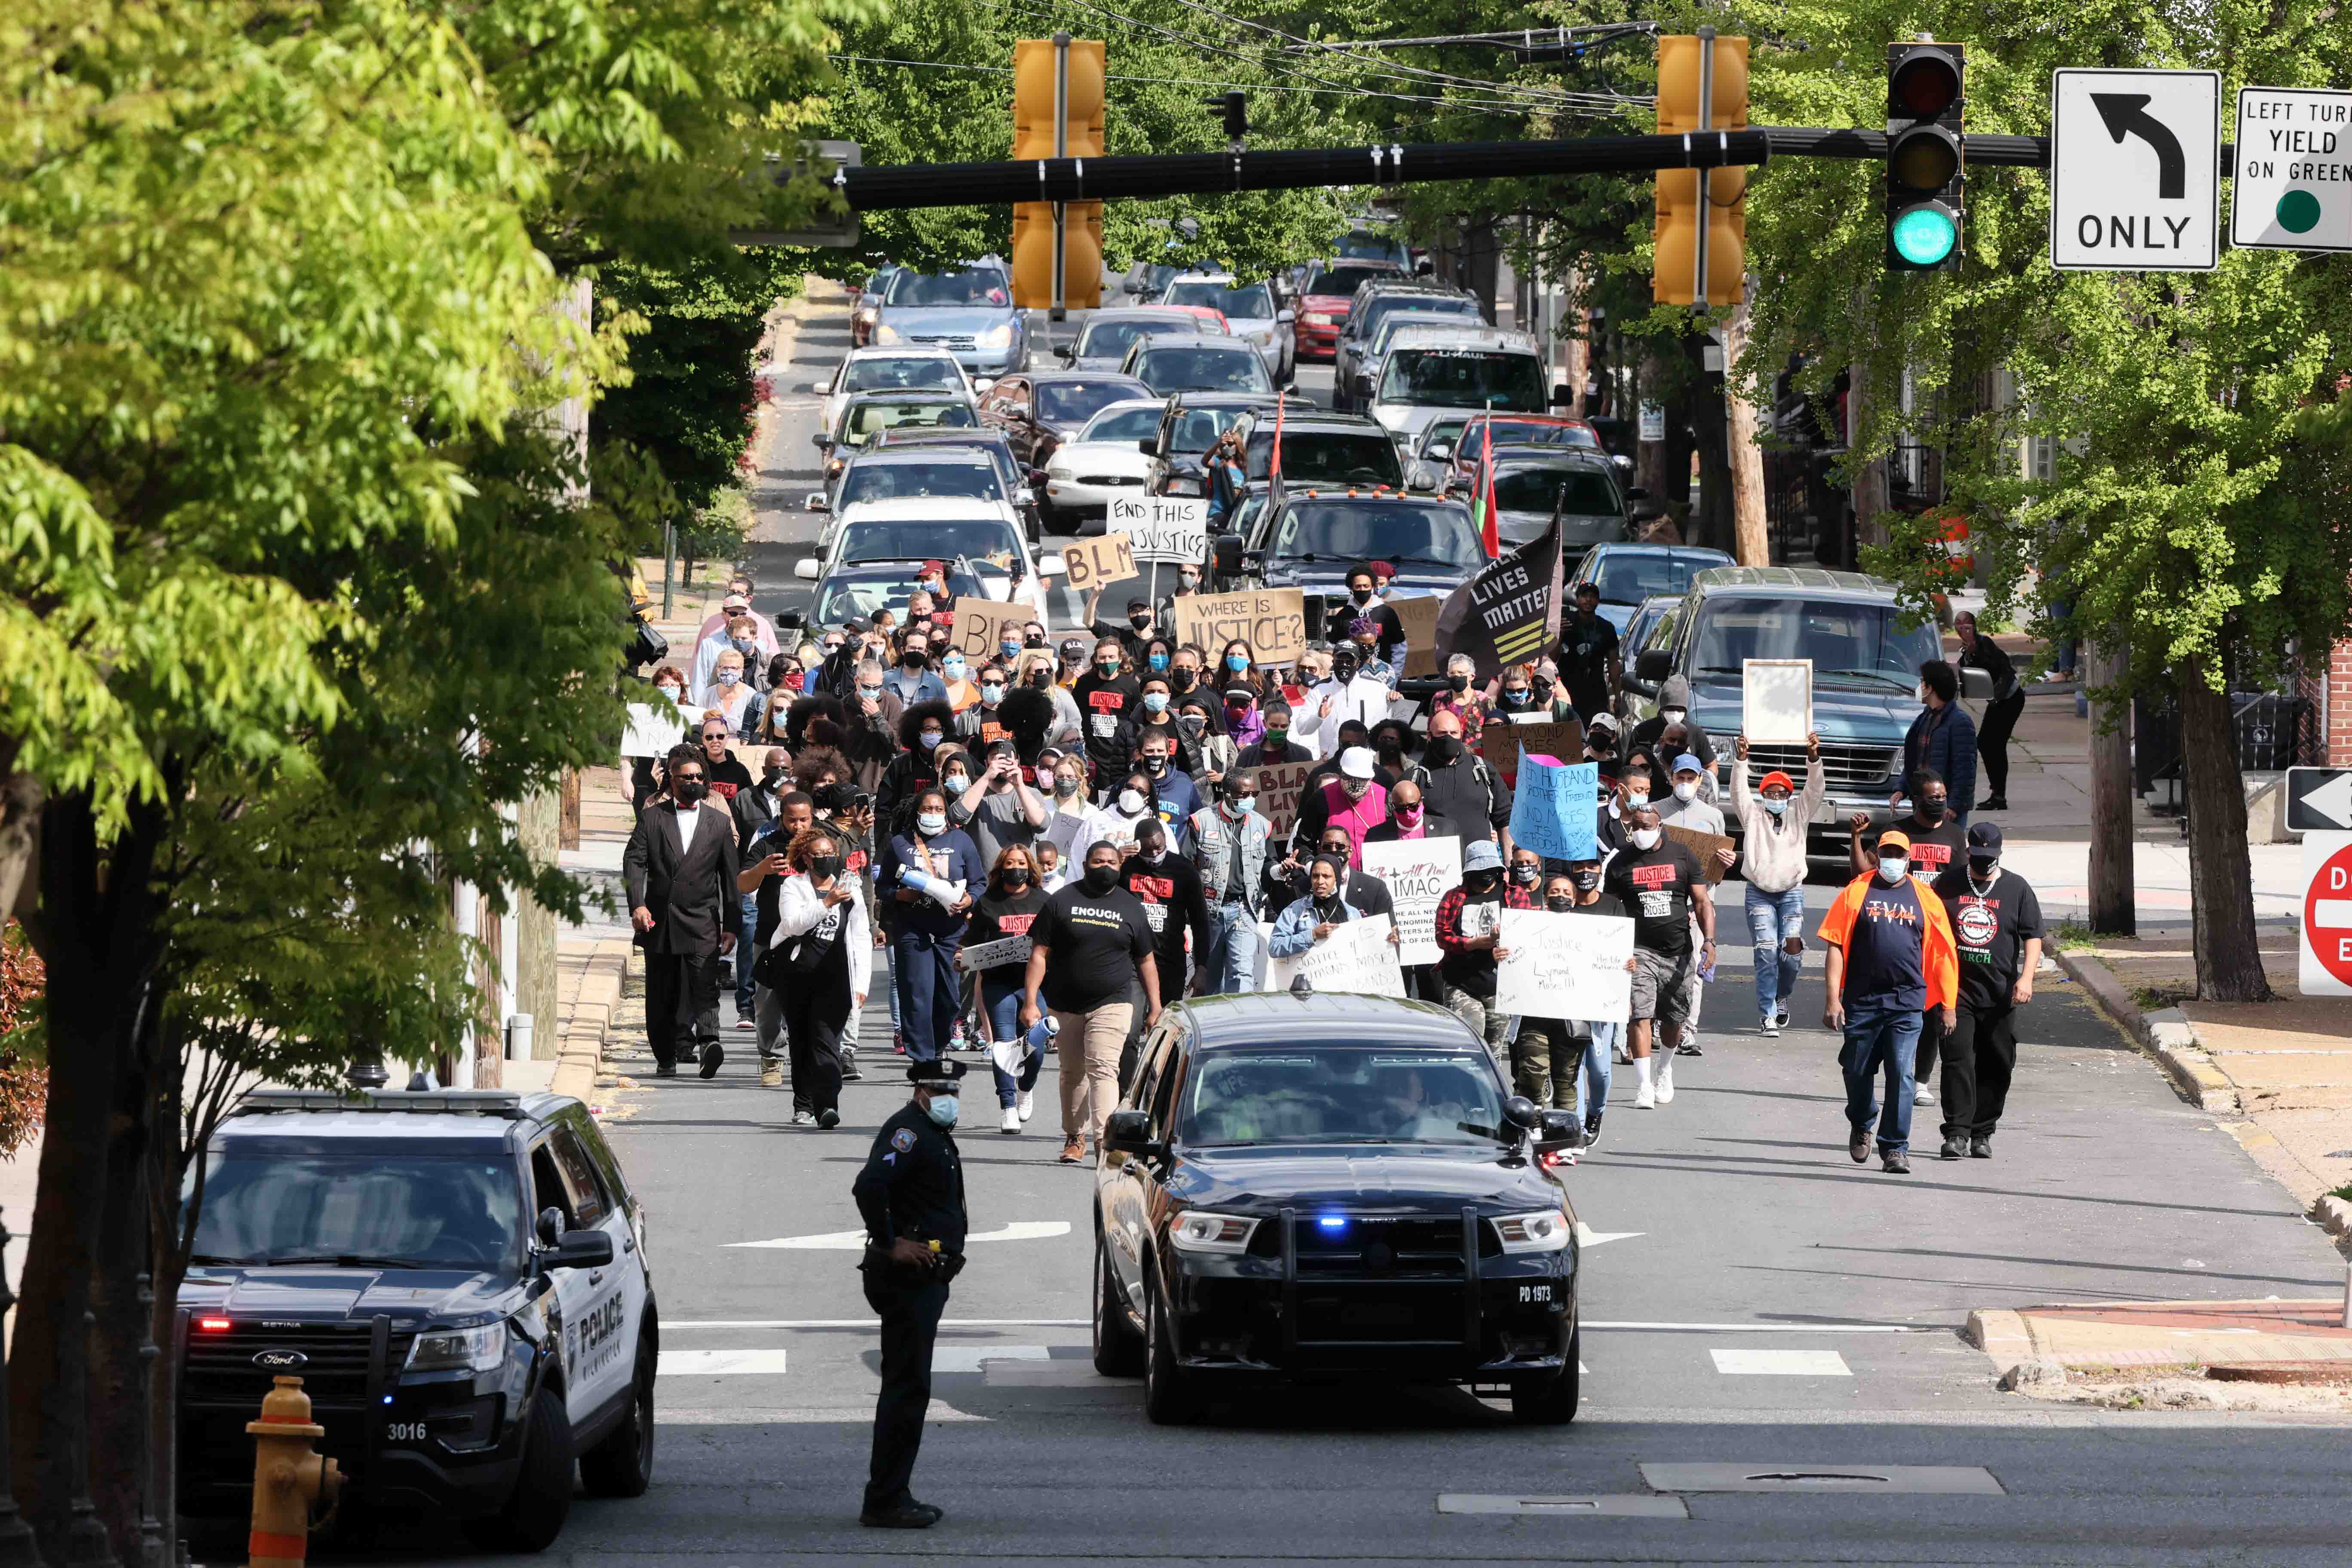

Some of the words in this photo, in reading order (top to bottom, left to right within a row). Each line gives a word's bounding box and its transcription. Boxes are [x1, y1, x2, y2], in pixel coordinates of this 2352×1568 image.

[2247, 102, 2293, 119] LEFT
[2309, 104, 2352, 122] TUR
[2269, 129, 2336, 154] YIELD
[2248, 161, 2273, 178] ON
[2078, 214, 2191, 249] ONLY
[1114, 499, 1146, 518] END
[1152, 505, 1194, 522] THIS
[1066, 541, 1137, 583] BLM
[1470, 566, 1529, 606] LIVES
[1197, 600, 1248, 617] WHERE
[1255, 598, 1271, 614] IS
[1092, 692, 1118, 706] JUSTICE
[1093, 726, 1114, 736] MOSES
[1508, 725, 1564, 739] LYMOND
[1541, 766, 1595, 788] HUSBAND
[1547, 808, 1588, 826] MOSES
[1915, 845, 1946, 861] JUSTICE
[1638, 866, 1670, 882] JUSTICE
[1924, 862, 1935, 870] FOR
[1135, 875, 1168, 895] JUSTICE
[1393, 877, 1441, 897] IMAC
[2331, 867, 2352, 890] D
[1639, 891, 1671, 903] LYMOND
[1987, 898, 2000, 909] MAN
[1071, 906, 1123, 922] ENOUGH.
[1645, 903, 1670, 916] MOSES
[1869, 900, 1914, 926] TVN
[1005, 916, 1035, 930] JUSTIC
[1396, 918, 1436, 926] ENOMINA
[1958, 925, 1988, 944] WASHINGTON
[1519, 1286, 1530, 1302] PD
[1532, 1286, 1551, 1302] 1973
[580, 1290, 624, 1357] POLICE
[264, 1354, 295, 1365] Ford
[388, 1423, 426, 1440] 3016
